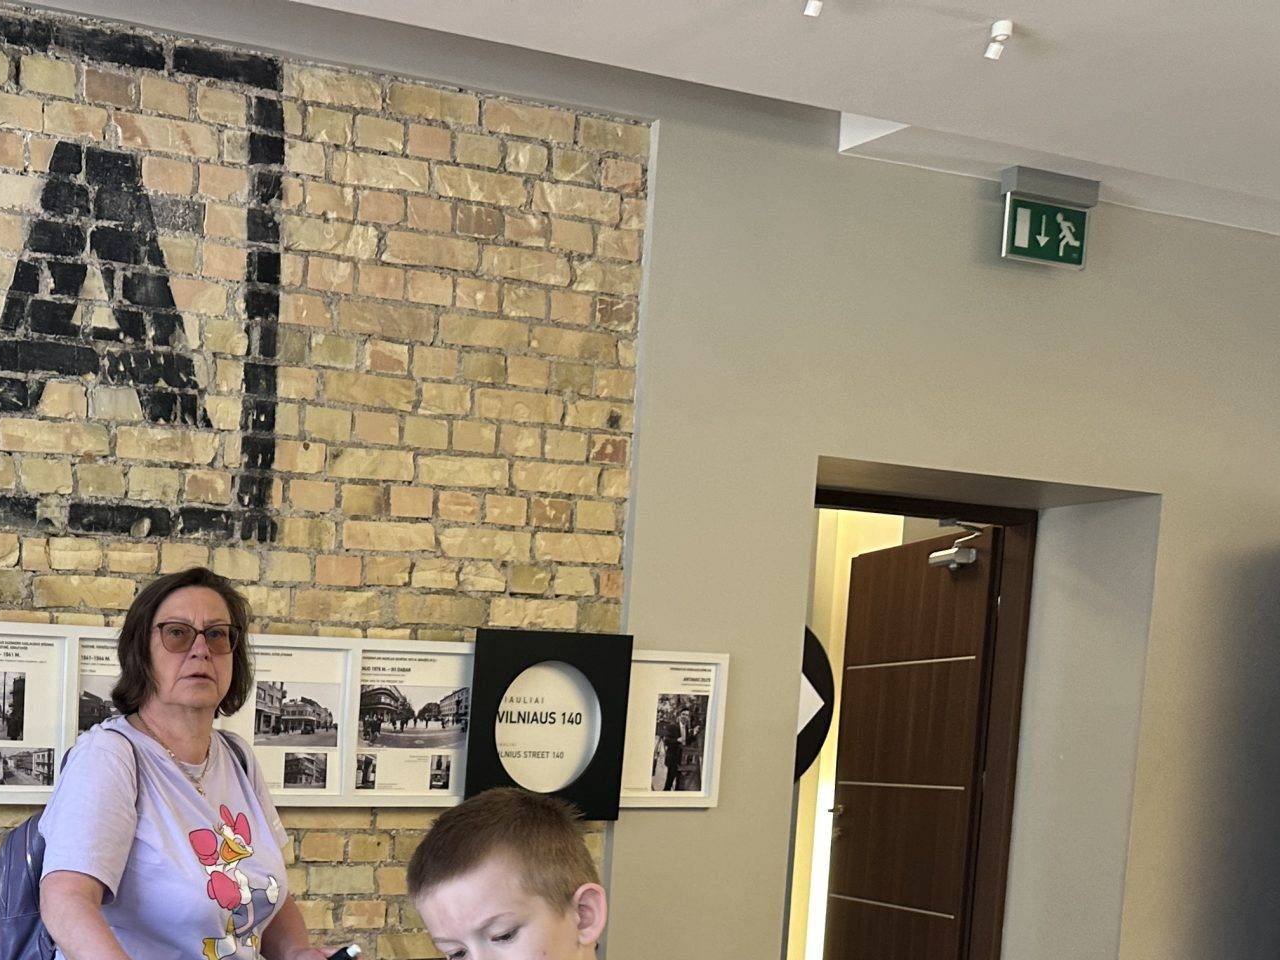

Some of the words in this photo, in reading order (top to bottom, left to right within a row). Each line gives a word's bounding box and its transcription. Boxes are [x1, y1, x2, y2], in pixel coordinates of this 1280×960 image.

[496, 710, 556, 725] VILNIAUS
[561, 711, 582, 725] 140
[523, 751, 550, 759] STREET
